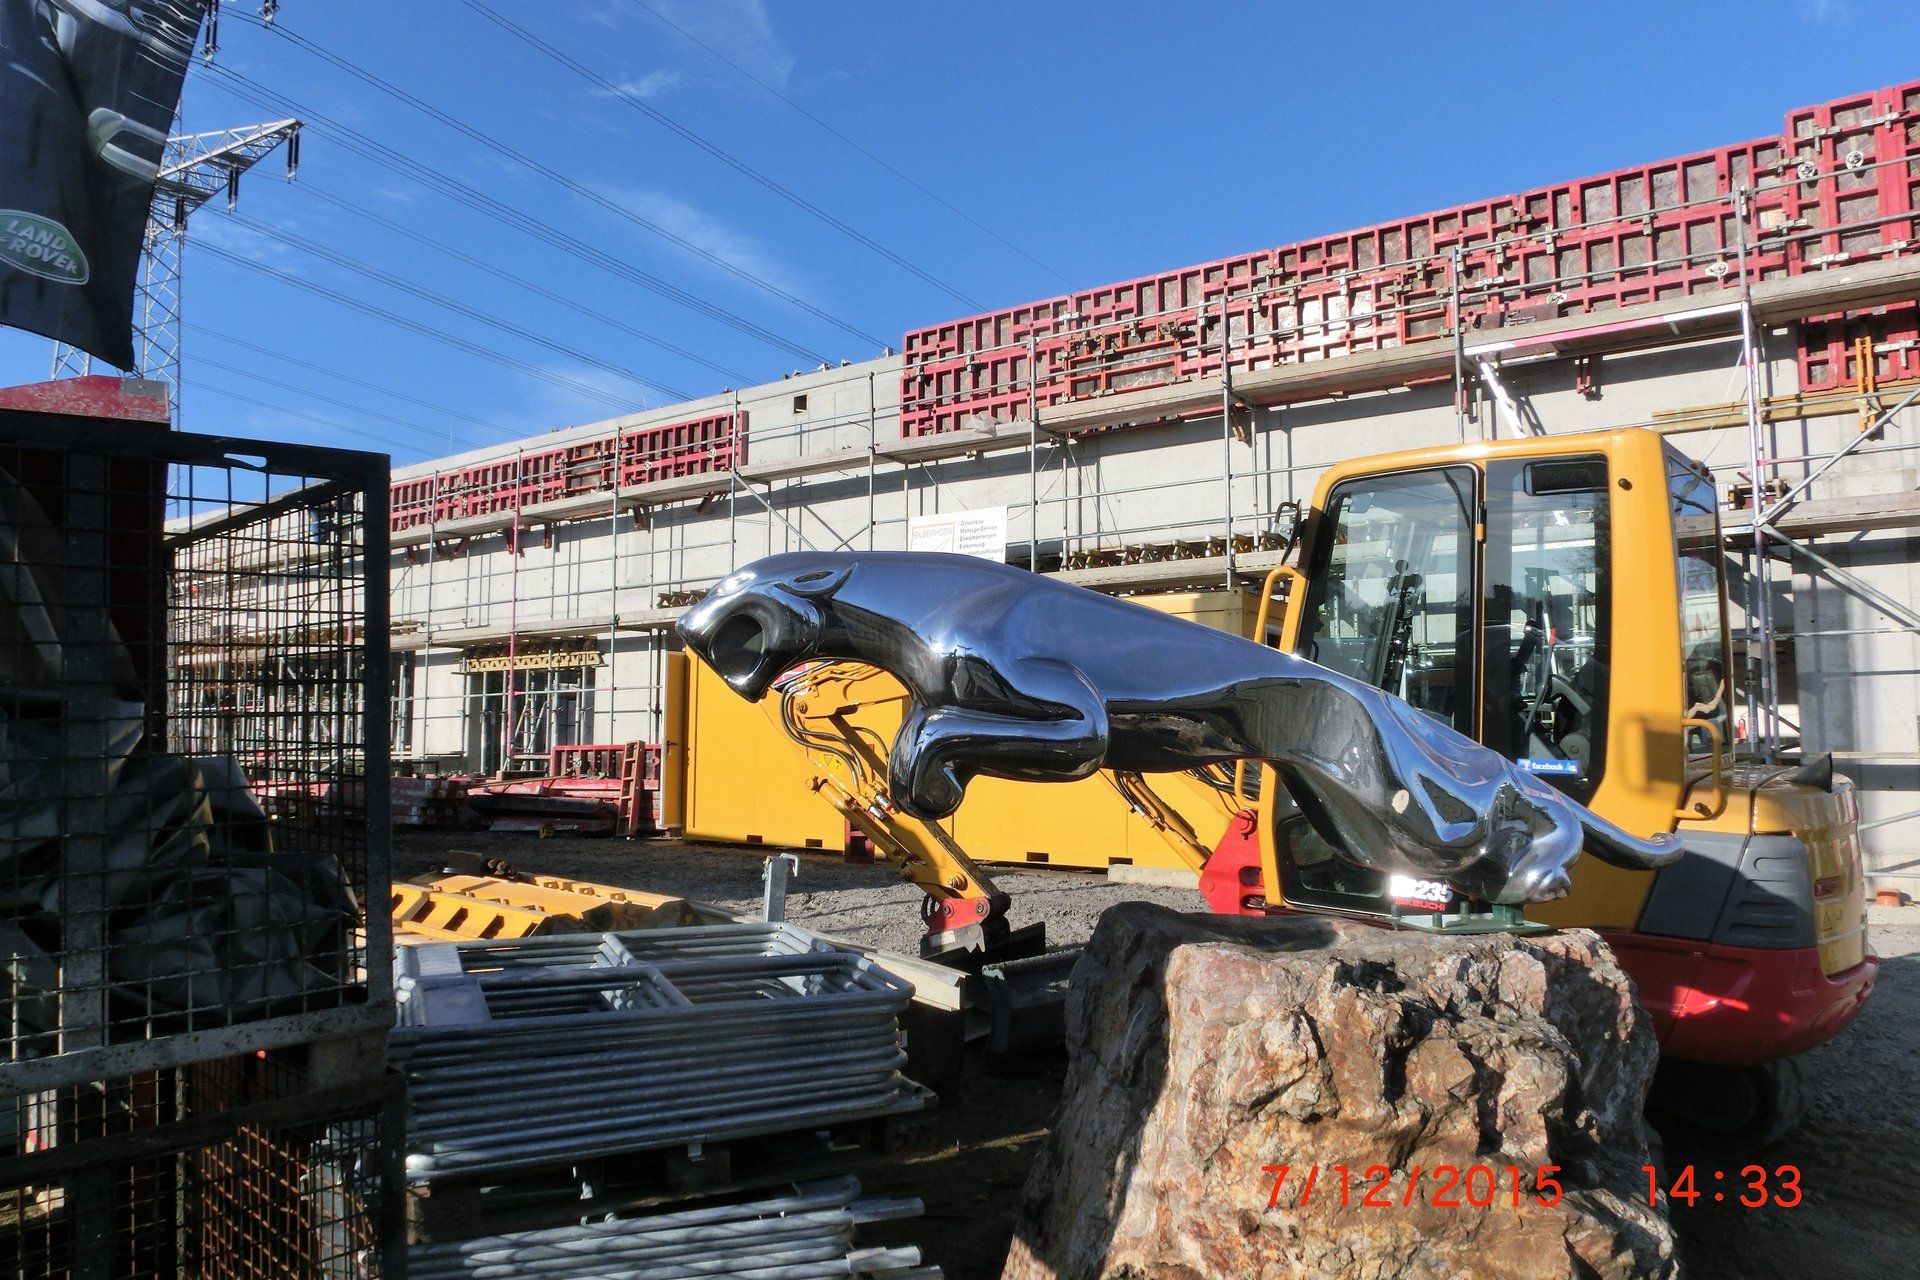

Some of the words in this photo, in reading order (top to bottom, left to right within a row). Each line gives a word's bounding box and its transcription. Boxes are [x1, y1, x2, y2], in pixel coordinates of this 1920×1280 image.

[6, 220, 67, 251] LAND
[8, 238, 78, 275] ROVER
[1531, 761, 1564, 771] facebook
